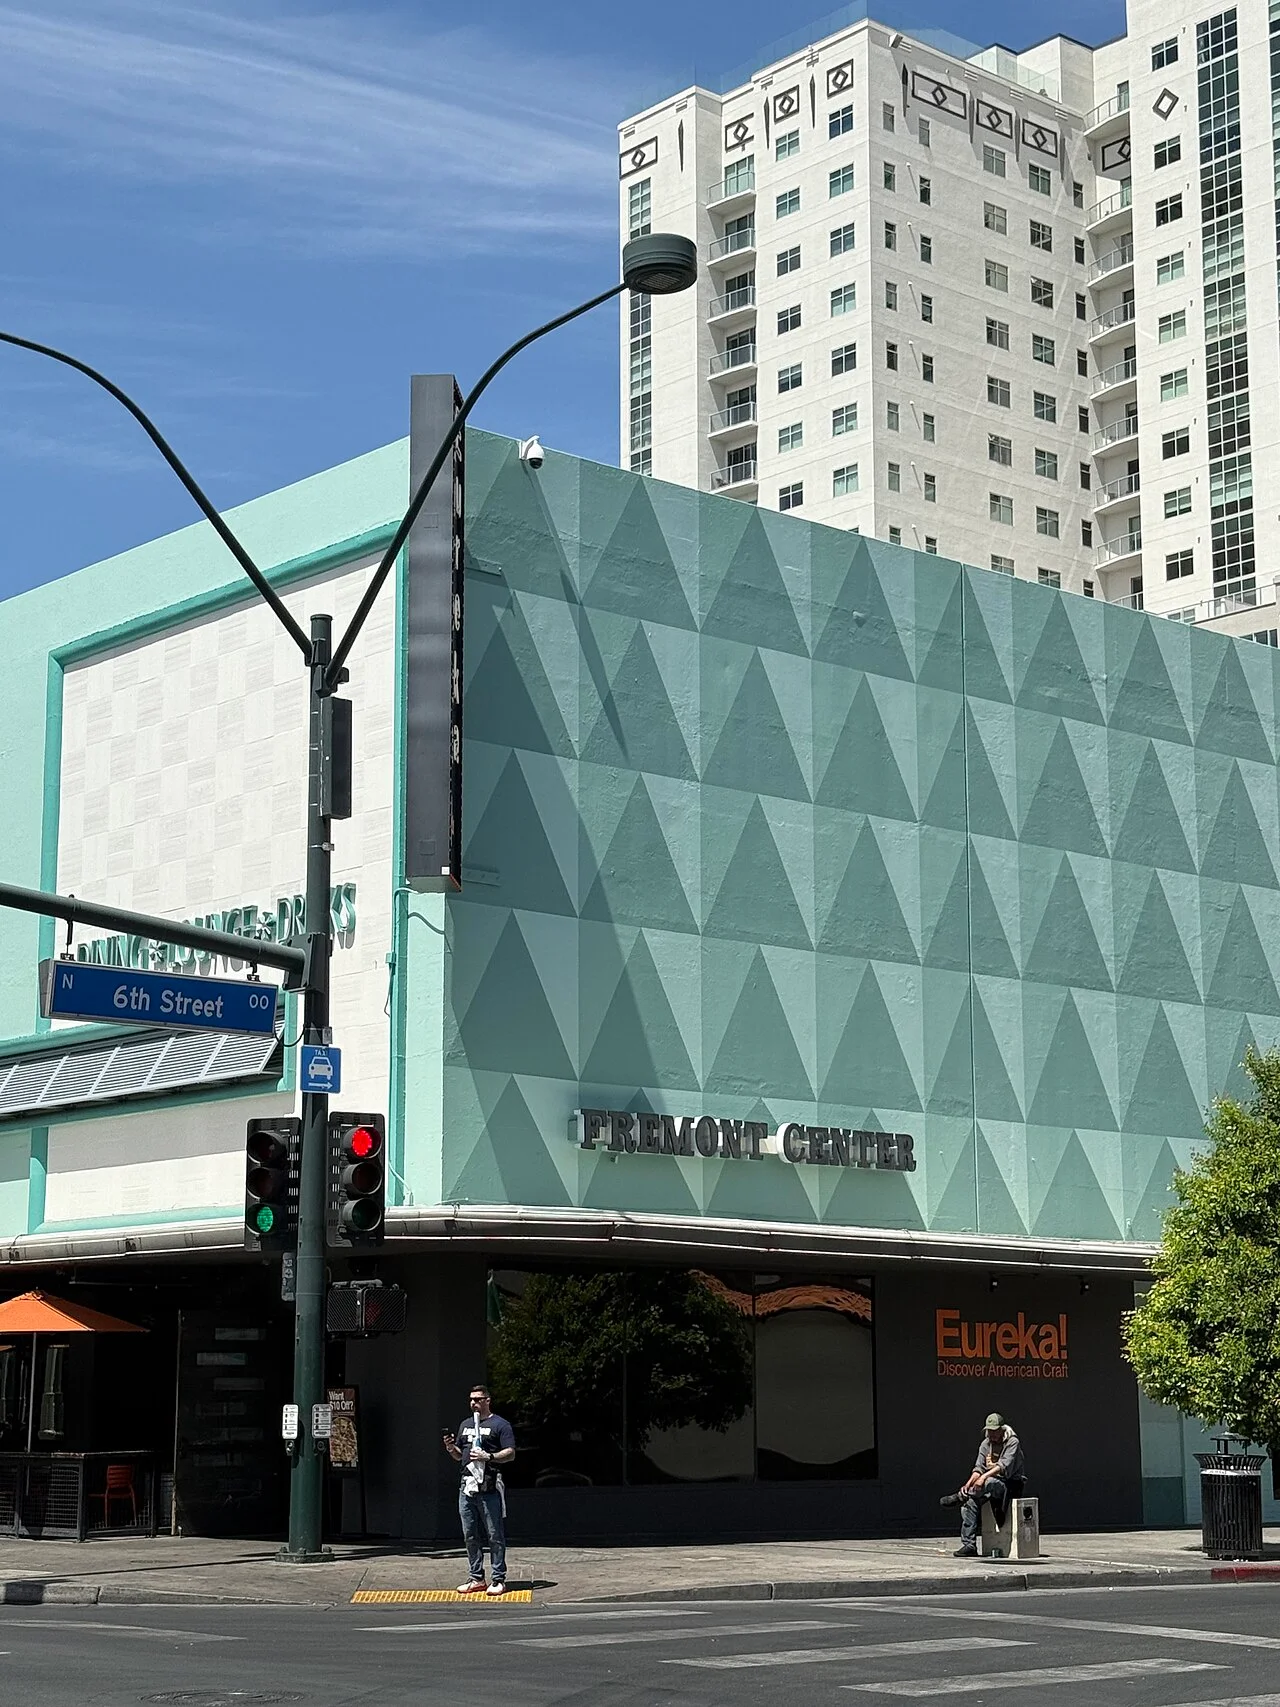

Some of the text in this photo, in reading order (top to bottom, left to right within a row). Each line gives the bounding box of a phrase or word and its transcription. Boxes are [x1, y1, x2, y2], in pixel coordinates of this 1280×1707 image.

[277, 883, 356, 943] DRKS
[62, 973, 73, 989] N
[113, 985, 224, 1019] 6th Street
[580, 1108, 917, 1172] FREMONT CENTER
[936, 1308, 1068, 1360] Eureka!
[937, 1360, 1069, 1378] Discover American Craft
